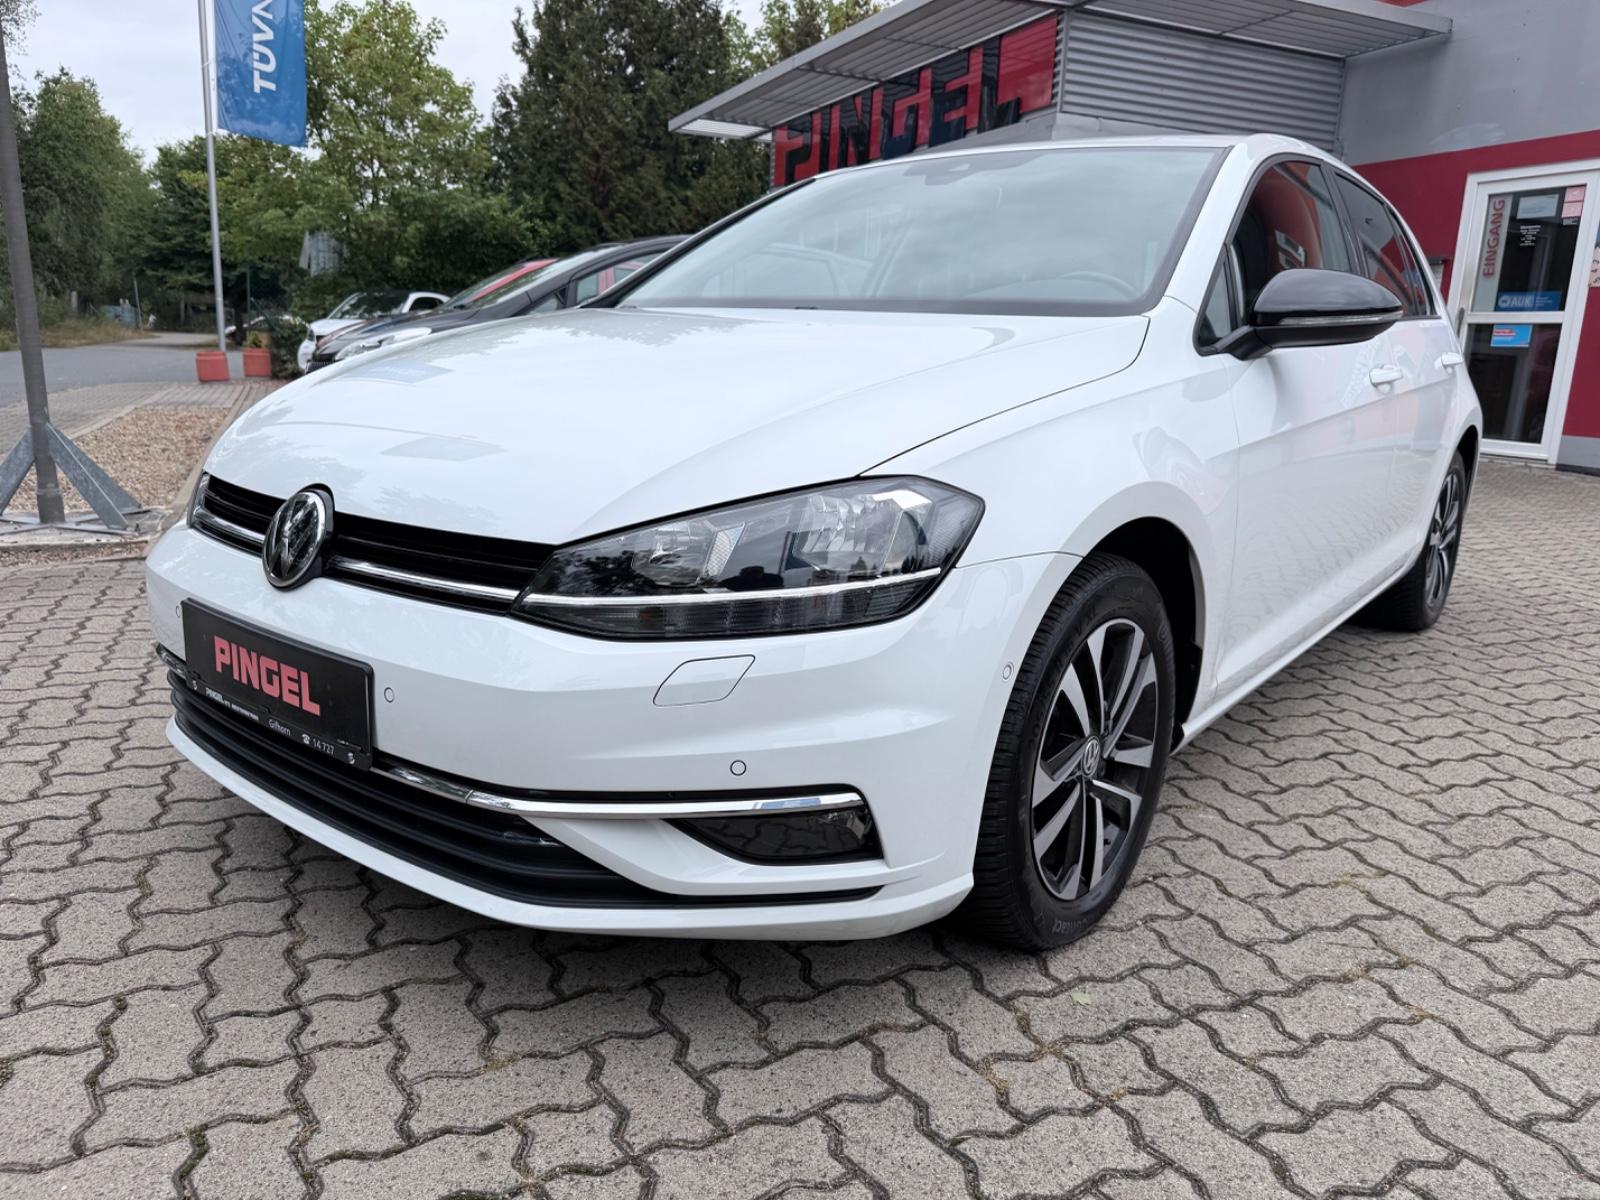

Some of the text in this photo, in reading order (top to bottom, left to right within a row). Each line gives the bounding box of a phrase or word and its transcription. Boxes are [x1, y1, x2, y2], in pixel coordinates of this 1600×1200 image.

[783, 36, 1021, 186] PINGEL
[1481, 199, 1506, 279] EINGANG
[213, 635, 321, 717] PINGEL
[268, 718, 291, 737] Gifhorn
